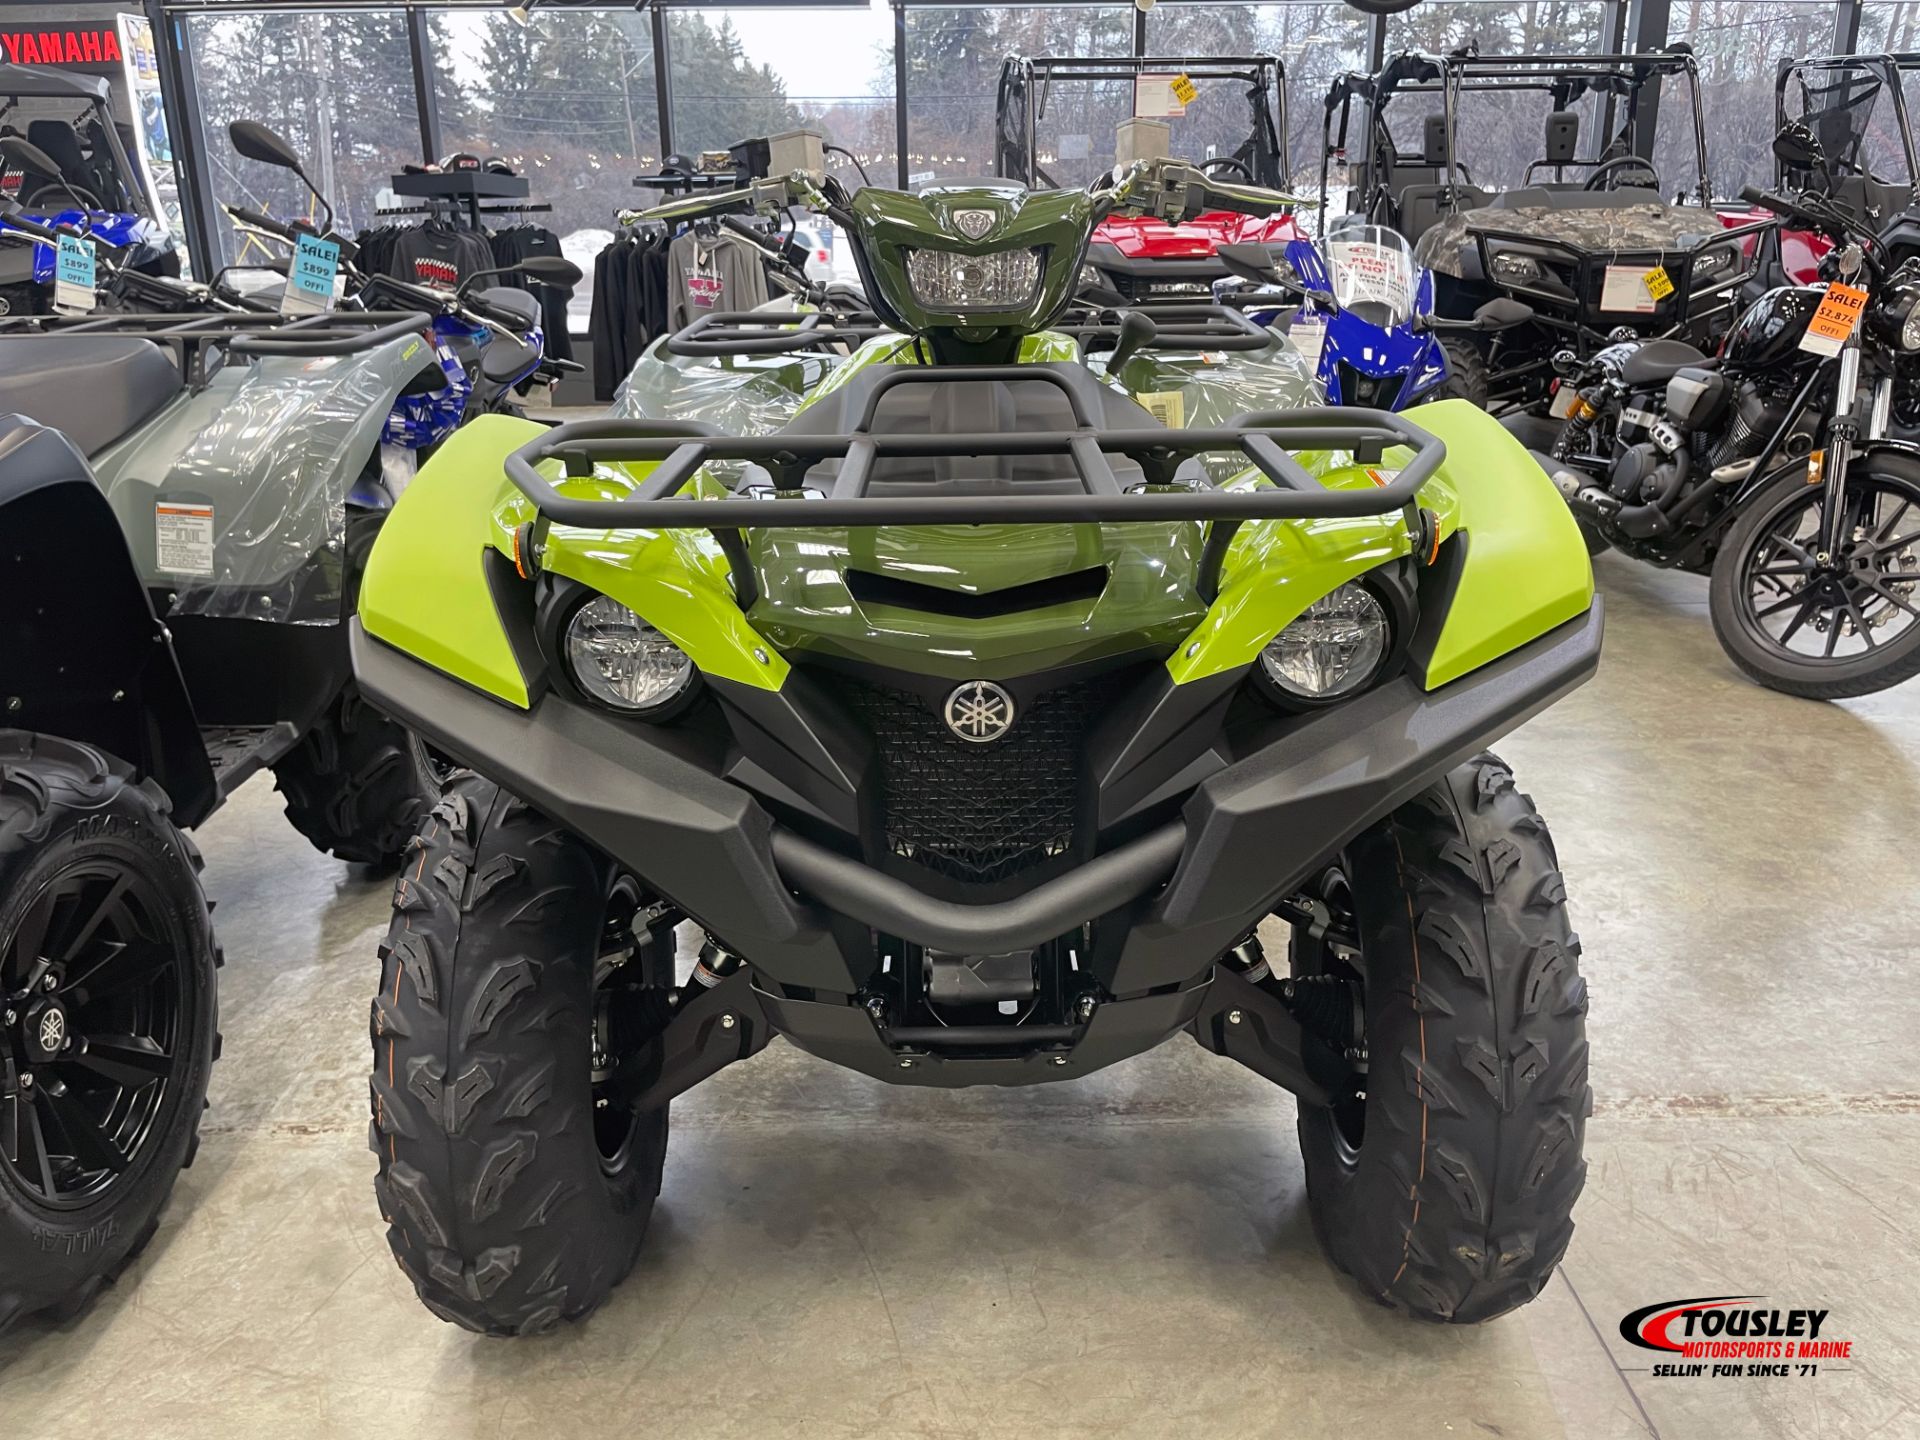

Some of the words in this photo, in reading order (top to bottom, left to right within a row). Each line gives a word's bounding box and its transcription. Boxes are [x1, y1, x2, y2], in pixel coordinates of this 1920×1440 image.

[2, 31, 122, 64] YAMAHA
[301, 243, 336, 263] SALE!
[64, 258, 89, 270] $899
[302, 262, 330, 276] $899
[67, 273, 85, 283] OFF!
[304, 280, 324, 292] OFF!
[1827, 291, 1863, 310] SALE!
[1820, 325, 1839, 336] OFF!
